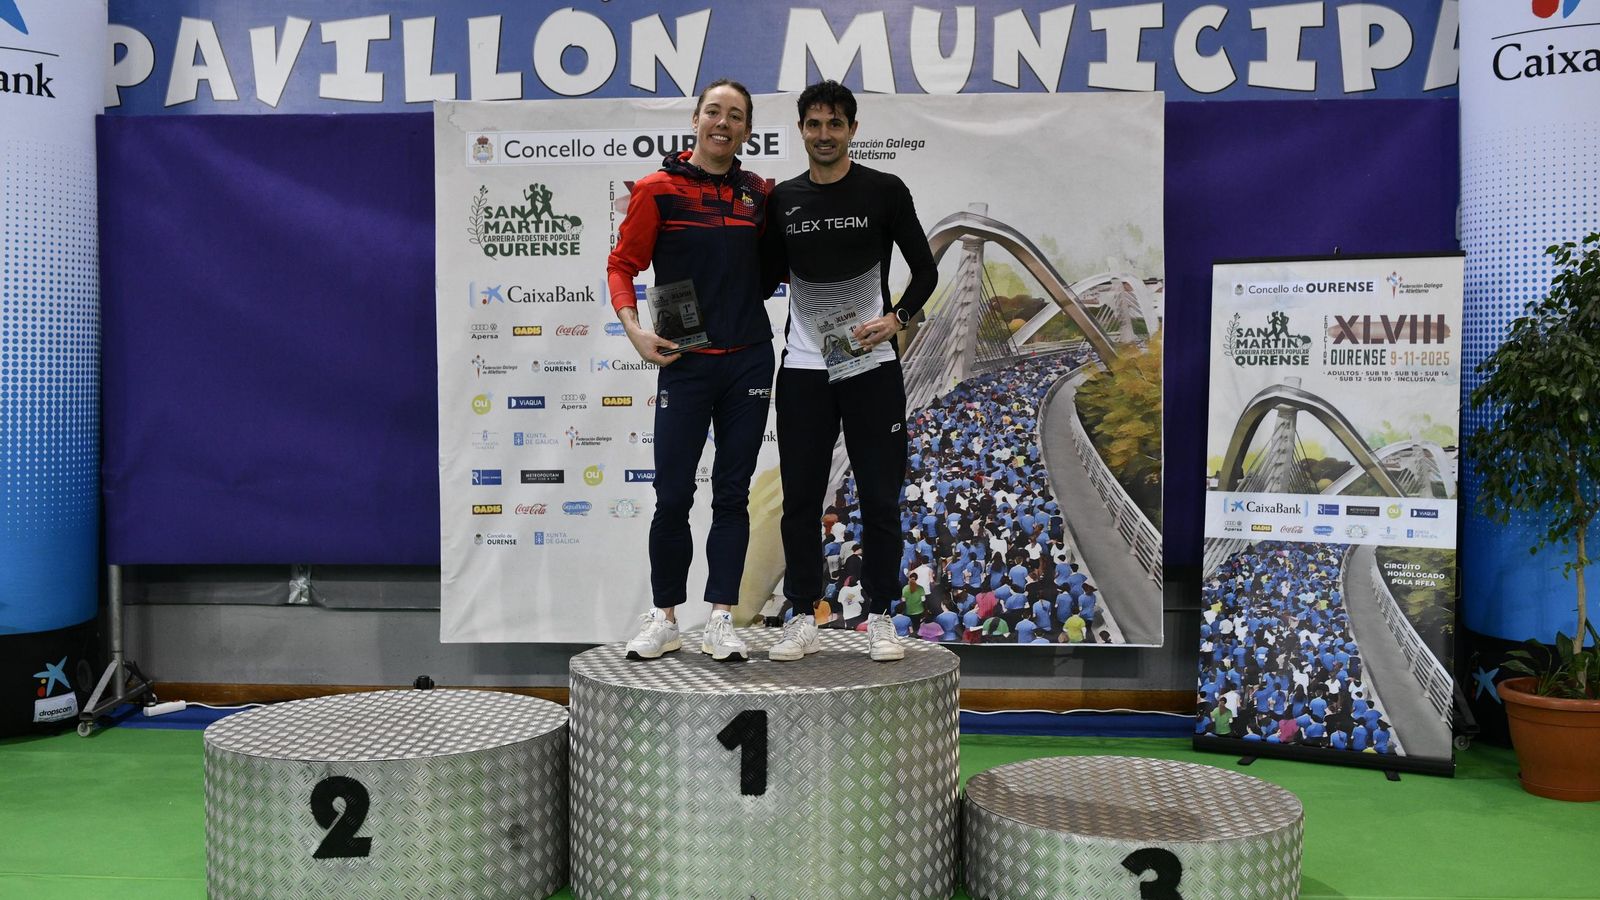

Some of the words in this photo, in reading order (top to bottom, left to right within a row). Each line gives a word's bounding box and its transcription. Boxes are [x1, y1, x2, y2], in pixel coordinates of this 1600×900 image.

[504, 139, 595, 158] Concello
[603, 138, 627, 157] de
[632, 133, 779, 158] OURSE
[886, 138, 925, 151] Galega
[848, 150, 896, 160] Atletismo
[484, 205, 526, 219] SAN
[484, 220, 566, 234] MARTIN
[785, 219, 820, 236] ALEX
[824, 216, 869, 231] TEAM
[516, 234, 548, 242] PEDESTRE
[550, 233, 580, 241] POPULAR
[484, 242, 580, 257] OURENSE
[507, 285, 596, 303] CaixaBank
[1248, 284, 1289, 294] Concello
[1292, 284, 1304, 293] de
[1306, 282, 1374, 293] OURENSE
[514, 327, 541, 335] GADIS
[1236, 327, 1268, 338] SAN
[1332, 314, 1445, 344] XLVIII
[1236, 338, 1299, 349] MARTIN
[1234, 355, 1310, 366] OURENSE
[1331, 349, 1387, 365] OURENSE
[1391, 351, 1450, 366] 9-11-2025
[612, 359, 660, 371] CaixaBan
[603, 397, 631, 406] GADIS
[474, 505, 502, 514] GADIS
[1246, 501, 1301, 514] CaixaBank
[1387, 571, 1445, 580] HOMOLOGADO
[39, 705, 73, 718] dropscom
[716, 709, 768, 796] 1
[310, 775, 372, 859] 2
[1121, 847, 1183, 900] 3
